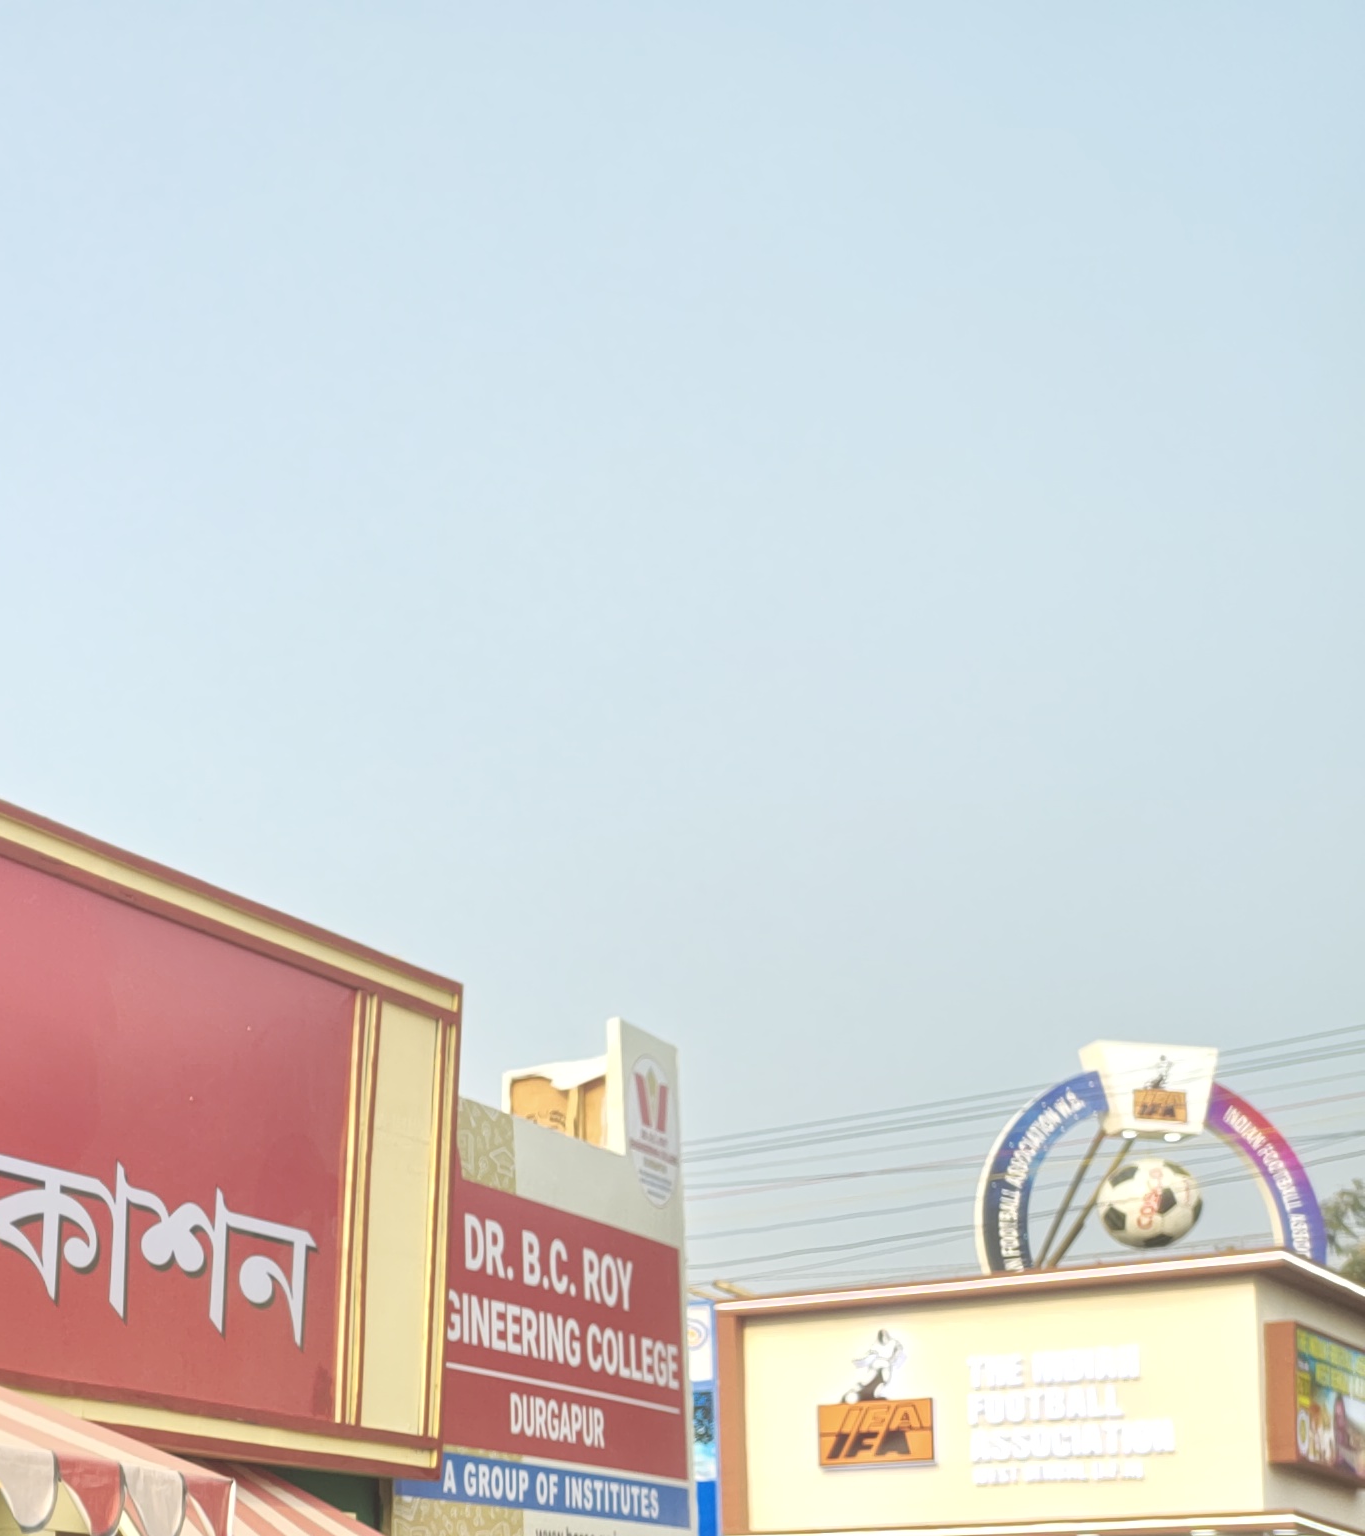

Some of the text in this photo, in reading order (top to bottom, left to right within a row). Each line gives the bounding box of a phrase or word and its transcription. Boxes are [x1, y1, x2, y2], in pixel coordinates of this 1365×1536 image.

[464, 1213, 633, 1312] DR. B.C. ROY
[586, 1323, 680, 1390] COLLEGE
[968, 1344, 1140, 1391] THE INDIAN
[510, 1392, 605, 1449] DURGAPUR
[968, 1384, 1125, 1427] FOOTBALL
[971, 1418, 1177, 1464] ASSOCIATION
[443, 1460, 659, 1520] A GROUP OF INSTITUTES
